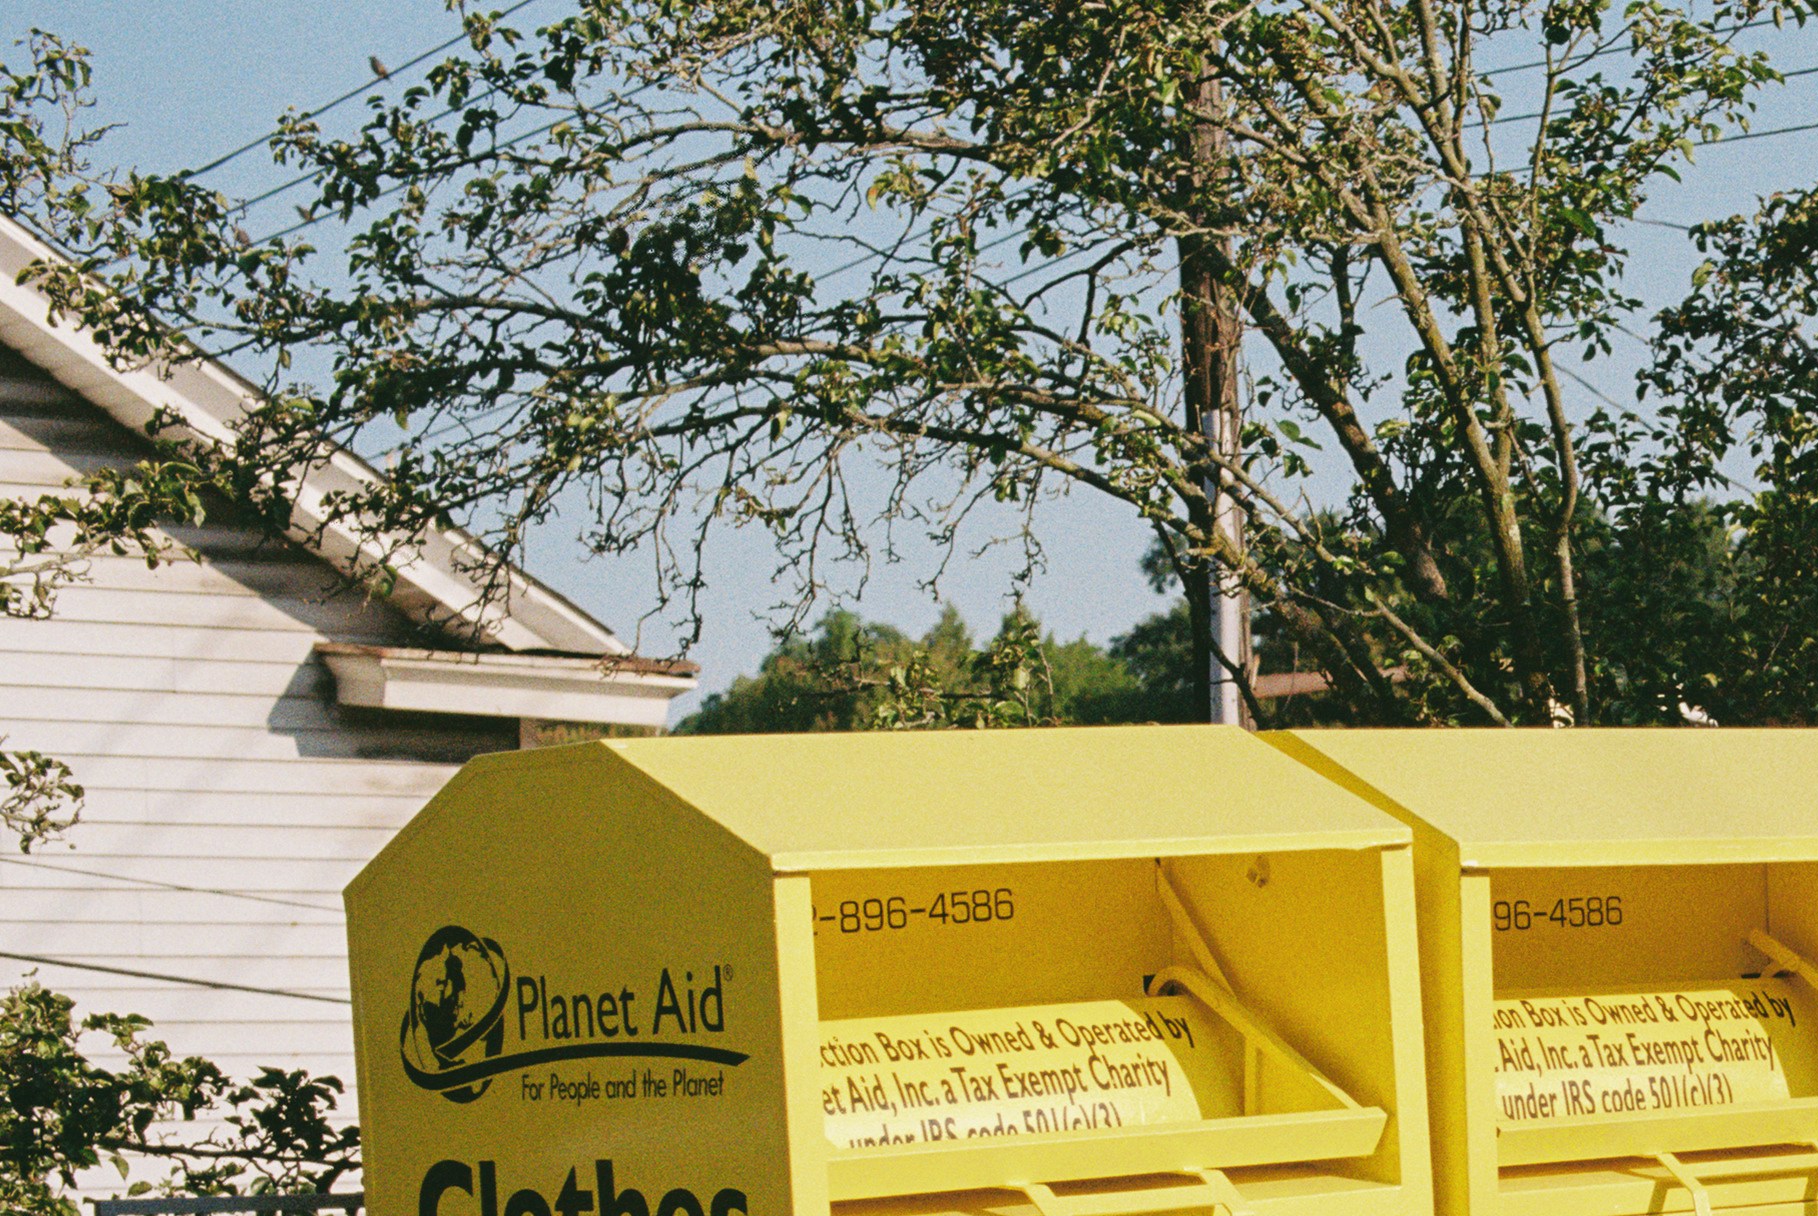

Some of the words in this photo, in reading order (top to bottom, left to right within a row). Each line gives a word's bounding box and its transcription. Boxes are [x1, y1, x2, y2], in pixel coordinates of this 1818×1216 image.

[515, 974, 638, 1040] Planet
[1520, 1000, 1569, 1027] Box
[1562, 1000, 1587, 1026] is
[1584, 996, 1659, 1025] Owned
[1655, 995, 1679, 1022] &
[1675, 991, 1769, 1029] Operated
[1762, 991, 1795, 1028] by
[820, 1036, 880, 1067] ction
[874, 1032, 930, 1061] Box
[926, 1030, 951, 1058] is
[949, 1022, 1035, 1055] Owned
[1033, 1020, 1058, 1049] &
[1056, 1011, 1163, 1055] Operated
[1158, 1011, 1195, 1048] by
[1499, 1037, 1542, 1077] Aid,
[1537, 1036, 1578, 1070] Inc.
[1578, 1045, 1593, 1068] a
[1586, 1034, 1629, 1067] Tax
[1625, 1032, 1704, 1074] Exempt
[1704, 1029, 1774, 1071] Charity
[521, 1073, 545, 1101] For
[549, 1071, 600, 1107] People
[605, 1068, 638, 1099] and
[642, 1069, 668, 1099] the
[672, 1069, 724, 1097] Planet
[892, 1072, 940, 1108] Inc.
[945, 1078, 958, 1105] a
[951, 1067, 997, 1102] Tax
[996, 1062, 1086, 1110] Exempt
[1088, 1052, 1172, 1096] Charity
[847, 1074, 897, 1117] Aid,
[1502, 1083, 1557, 1120] under
[1562, 1080, 1596, 1116] IRS
[1602, 1078, 1646, 1112] code
